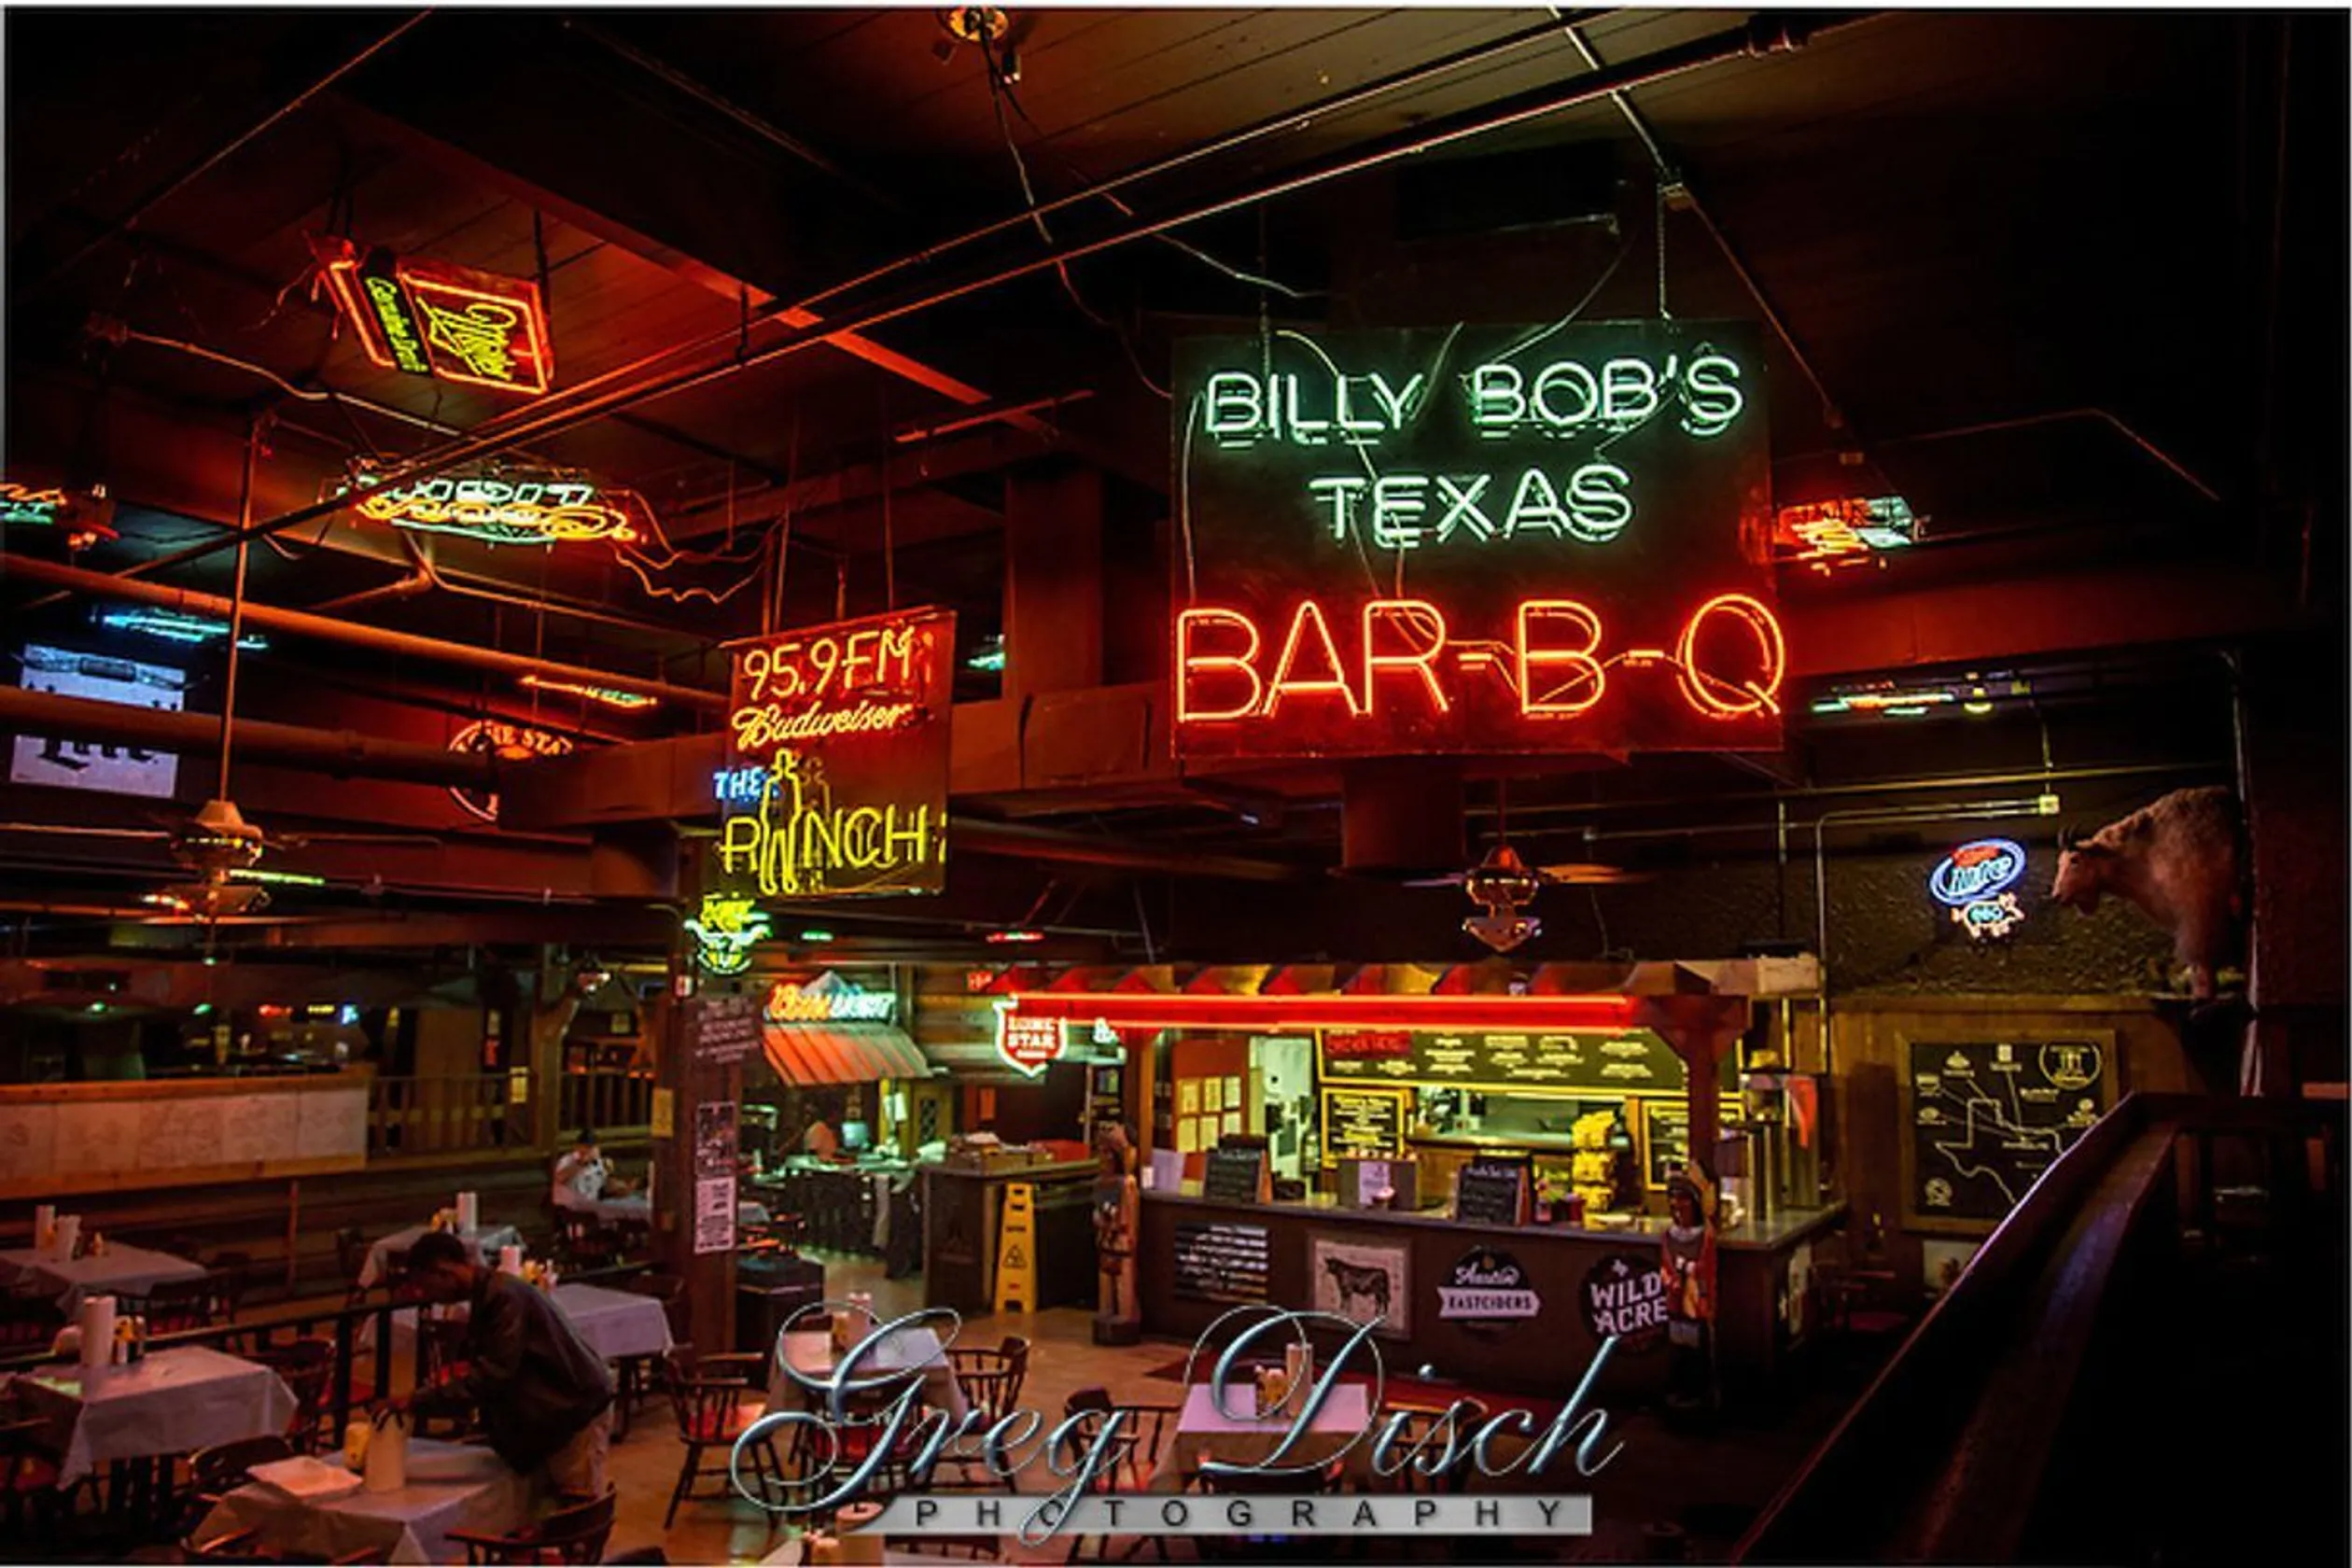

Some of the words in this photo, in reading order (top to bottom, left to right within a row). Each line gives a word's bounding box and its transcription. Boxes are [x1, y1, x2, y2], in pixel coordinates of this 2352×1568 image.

[1206, 371, 1424, 442] BILLY
[1472, 354, 1744, 429] BOB'S
[1309, 464, 1634, 546] TEXAS
[1177, 593, 1785, 723] BAR-B-Q
[731, 701, 913, 750] Budweiser
[712, 766, 768, 800] THE
[1007, 1032, 1056, 1049] STAR
[1589, 1270, 1662, 1309] WILD
[1592, 1296, 1670, 1335] ACRE
